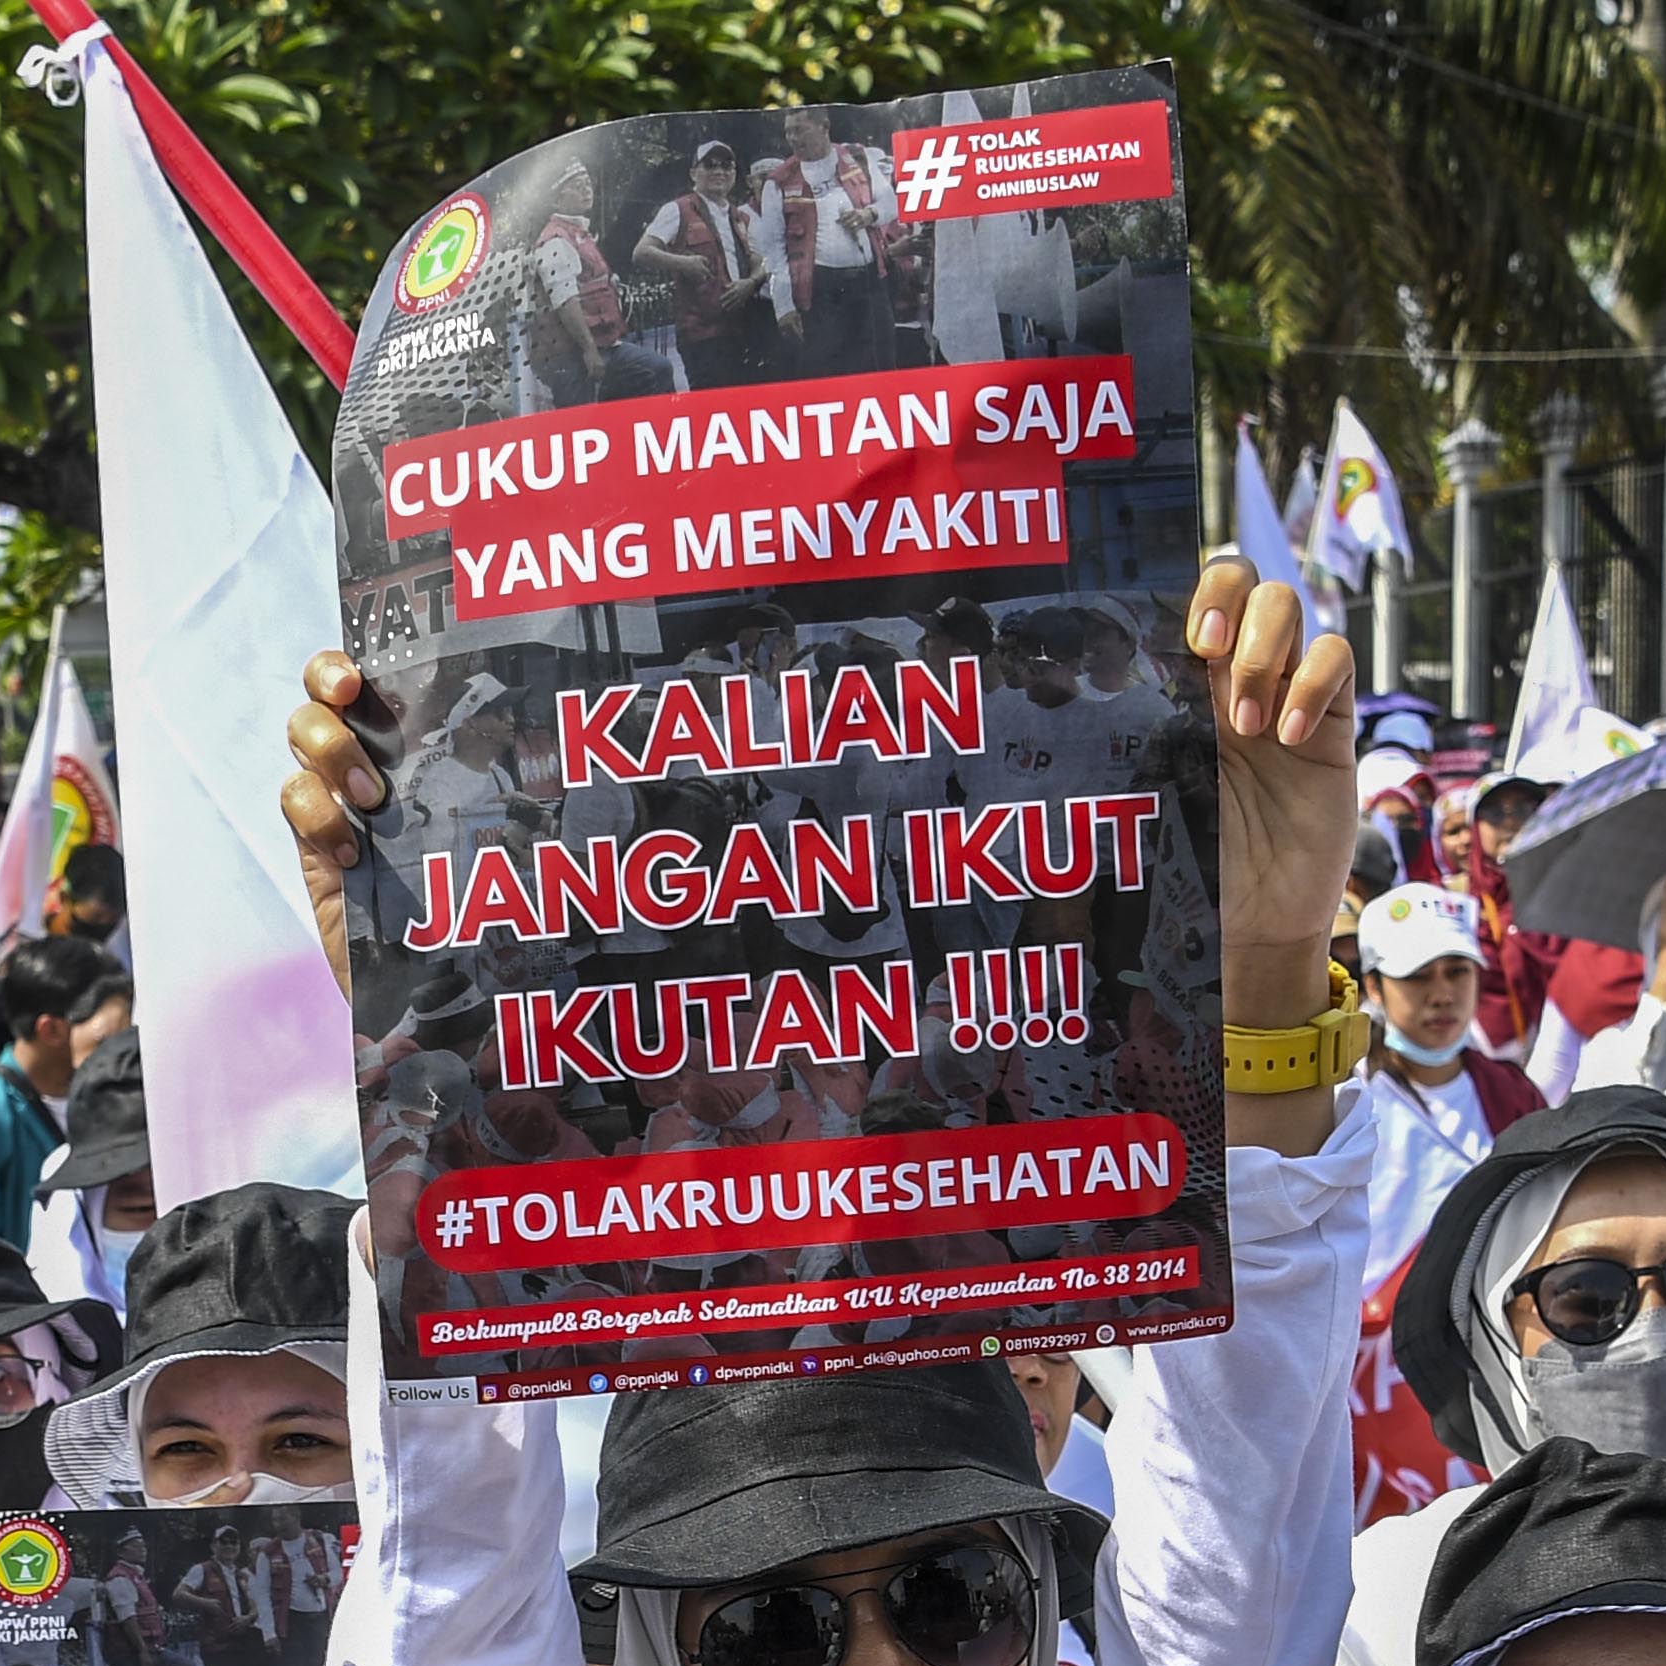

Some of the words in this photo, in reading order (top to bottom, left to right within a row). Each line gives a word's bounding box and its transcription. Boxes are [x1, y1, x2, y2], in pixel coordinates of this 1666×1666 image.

[968, 129, 1041, 152] TOLAK
[975, 141, 1140, 174] RUUKESEHATAN
[977, 172, 1099, 199] OMNIBUSLAW
[377, 352, 407, 376] DKI
[409, 327, 496, 369] JAKARTA
[389, 327, 429, 357] DPW
[433, 313, 478, 340] PPNI
[389, 429, 610, 517] CUKUP
[633, 391, 952, 476] MANTAN
[974, 381, 1133, 454] SAJA
[455, 523, 649, 599] YANG
[674, 487, 1062, 571] MENYAKITI
[555, 655, 985, 788] KALIAN
[402, 813, 880, 953] JANGAN
[903, 792, 1160, 908] IKUT
[494, 961, 920, 1090] IKUTAN
[946, 942, 1092, 1053] !!!!
[436, 1140, 1170, 1247] #TOLAKRUUKESEHATAN
[698, 1291, 838, 1321] Selamatkan
[846, 1285, 894, 1309] UU
[899, 1271, 1056, 1310] Keperawatan
[1060, 1267, 1099, 1291] No
[1104, 1265, 1130, 1284] 38
[1134, 1258, 1186, 1281] 2014
[388, 1386, 443, 1401] Follow
[448, 1385, 470, 1400] Us
[508, 1379, 572, 1400] @ppnidki
[615, 1371, 679, 1392] @ppnidki
[714, 1362, 795, 1382] dpwppnidki
[824, 1343, 971, 1374] ppni_dki@yahoo.com
[1005, 1332, 1087, 1353] 08119292997
[1127, 1314, 1226, 1338] www.ppnidki.org
[14, 1627, 78, 1645] JAKARTA
[30, 1616, 65, 1629] PPNI
